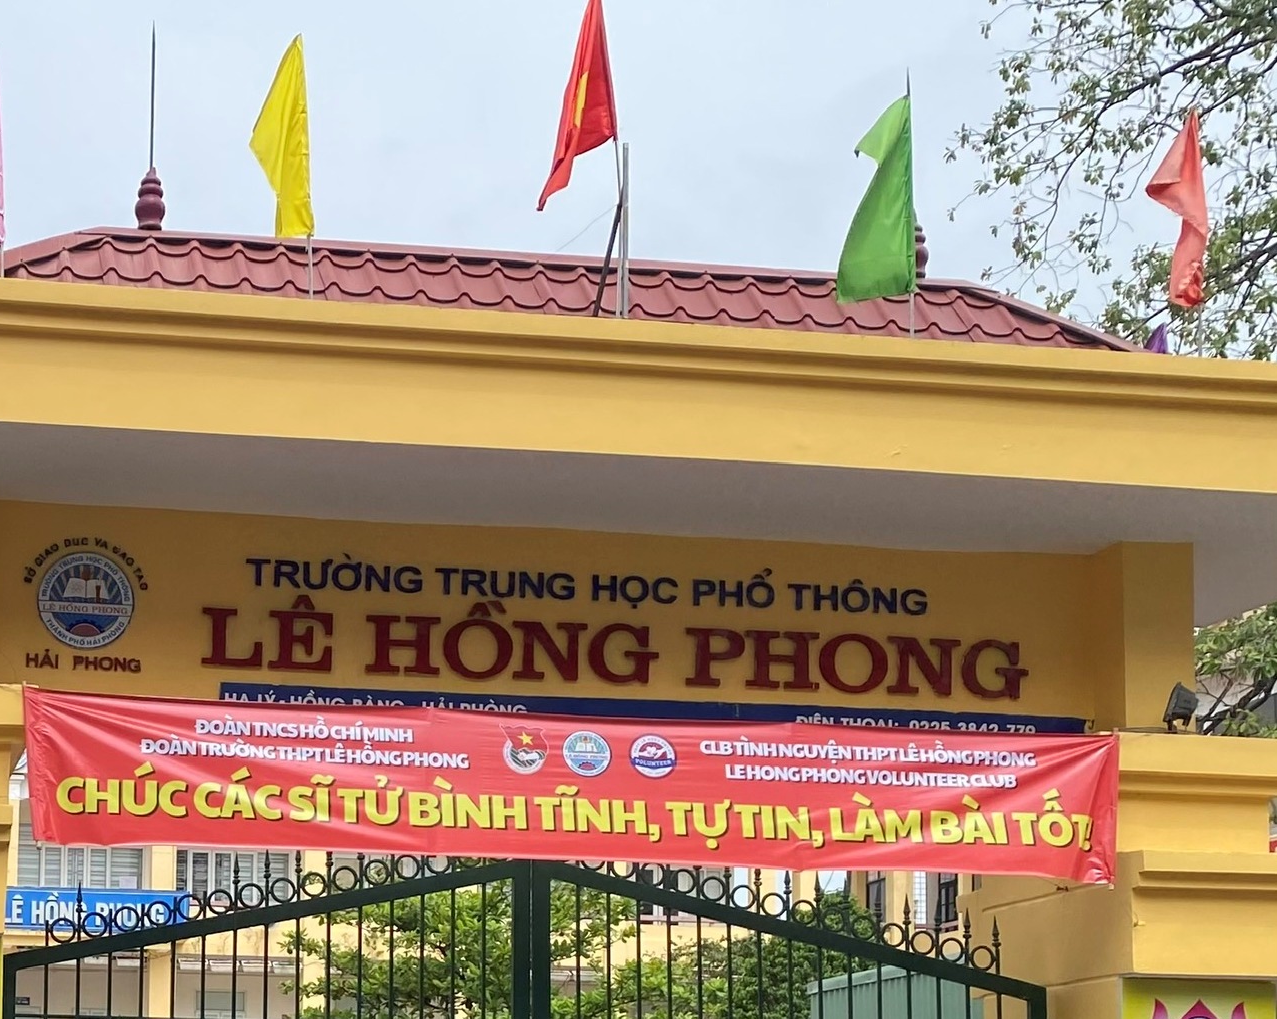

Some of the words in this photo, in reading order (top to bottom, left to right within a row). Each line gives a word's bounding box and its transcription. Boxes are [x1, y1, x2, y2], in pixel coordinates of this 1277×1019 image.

[246, 552, 423, 594] TRƯỜNG
[435, 568, 575, 600] TRUNG
[592, 574, 678, 610] HỌC
[691, 568, 775, 609] PHỔ
[787, 580, 929, 615] THÔNG
[72, 655, 141, 673] PHONG
[201, 595, 335, 674] LÊ
[366, 601, 659, 685] HỒNG
[685, 627, 1030, 700] PHONG
[195, 716, 251, 737] ĐOÀN
[252, 723, 300, 740] TNCS
[300, 716, 333, 741] HỒ
[333, 721, 363, 741] CHÍ
[362, 727, 413, 743] MINH
[140, 735, 197, 756] ĐOÀN
[198, 739, 277, 760] TRƯỜNG
[277, 746, 324, 762] THPT
[324, 743, 348, 763] LÊ
[347, 739, 406, 765] HỒNG
[406, 751, 470, 769] PHONG
[700, 740, 732, 757] CLB
[732, 735, 778, 758] TÌNH
[777, 739, 854, 764] NGUYỆN
[852, 746, 900, 762] THPT
[899, 744, 924, 762] LÊ
[923, 740, 975, 765] HỒNG
[974, 752, 1037, 768] PHONG
[725, 764, 748, 779] LE
[747, 765, 802, 782] HONG
[801, 768, 866, 785] PHONG
[869, 770, 972, 789] VOLUNTEER
[971, 774, 1017, 790] CLUB
[55, 761, 187, 817] CHÚC
[193, 766, 283, 821] CÁC
[289, 775, 331, 822] SĨ
[337, 773, 404, 827] TỬ
[408, 776, 529, 831] BÌNH
[534, 784, 660, 843] TĨNH,
[665, 799, 732, 850] TỰ
[733, 803, 824, 849] TIN,
[830, 791, 924, 844] LÀM
[930, 792, 1009, 846] BÀI
[1013, 788, 1094, 852] TỐT!
